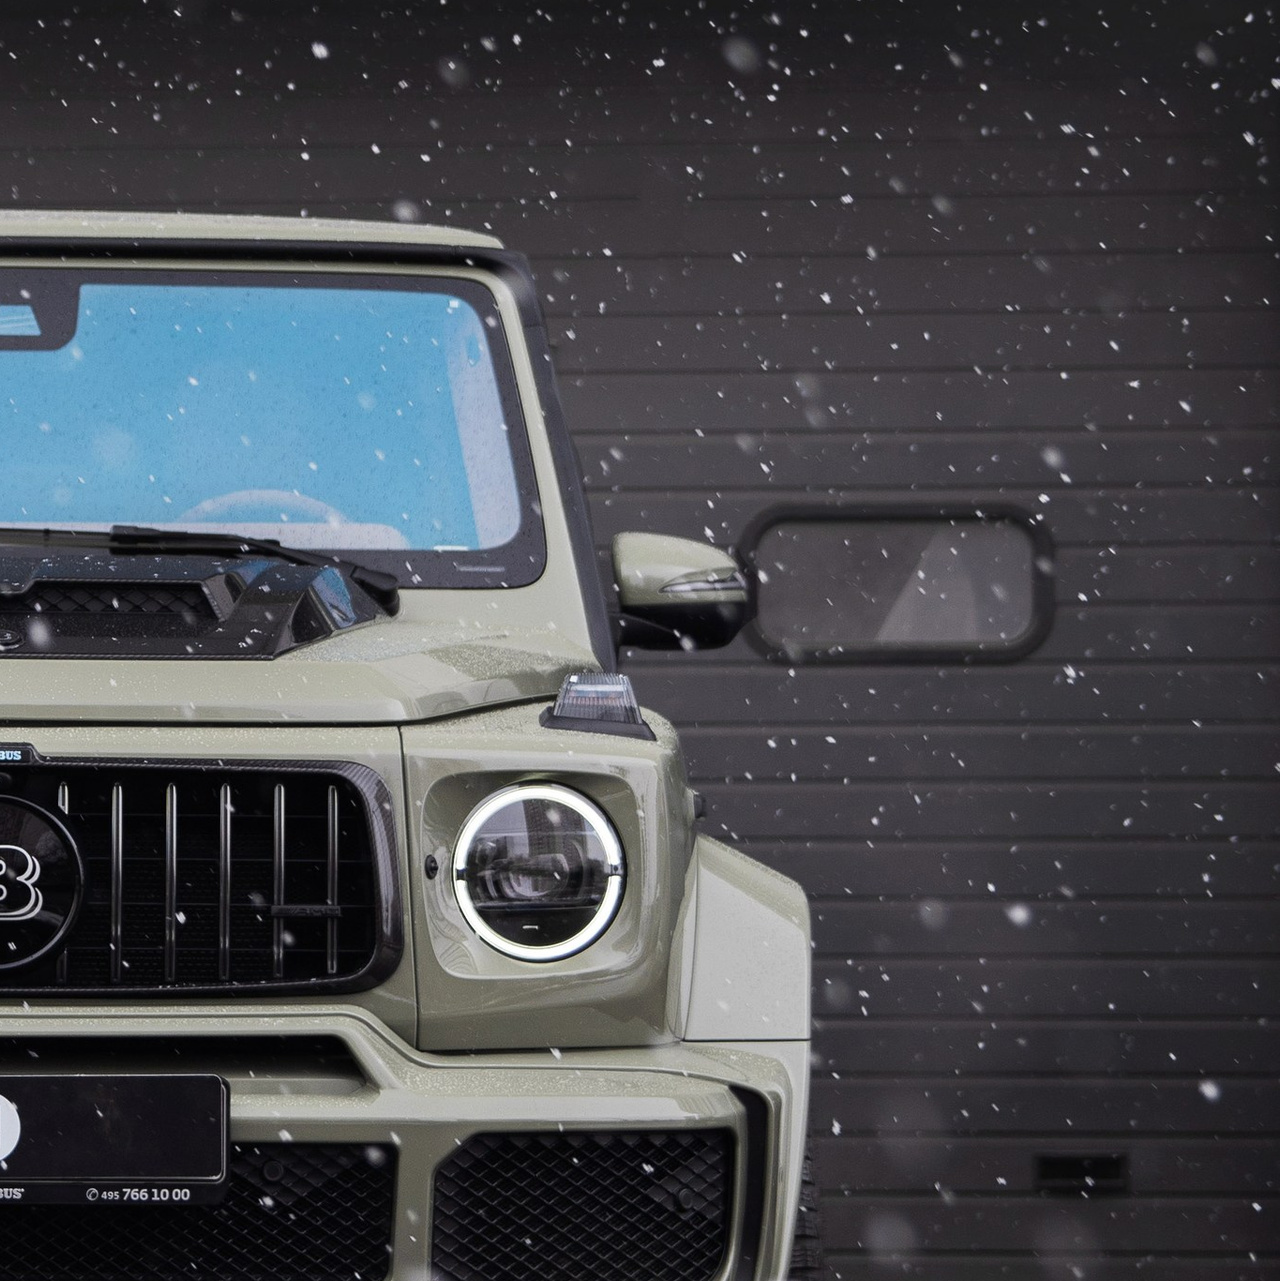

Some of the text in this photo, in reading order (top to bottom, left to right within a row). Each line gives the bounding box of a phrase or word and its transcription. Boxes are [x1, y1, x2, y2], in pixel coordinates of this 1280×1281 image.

[101, 1188, 190, 1201] 495 766 10 00
